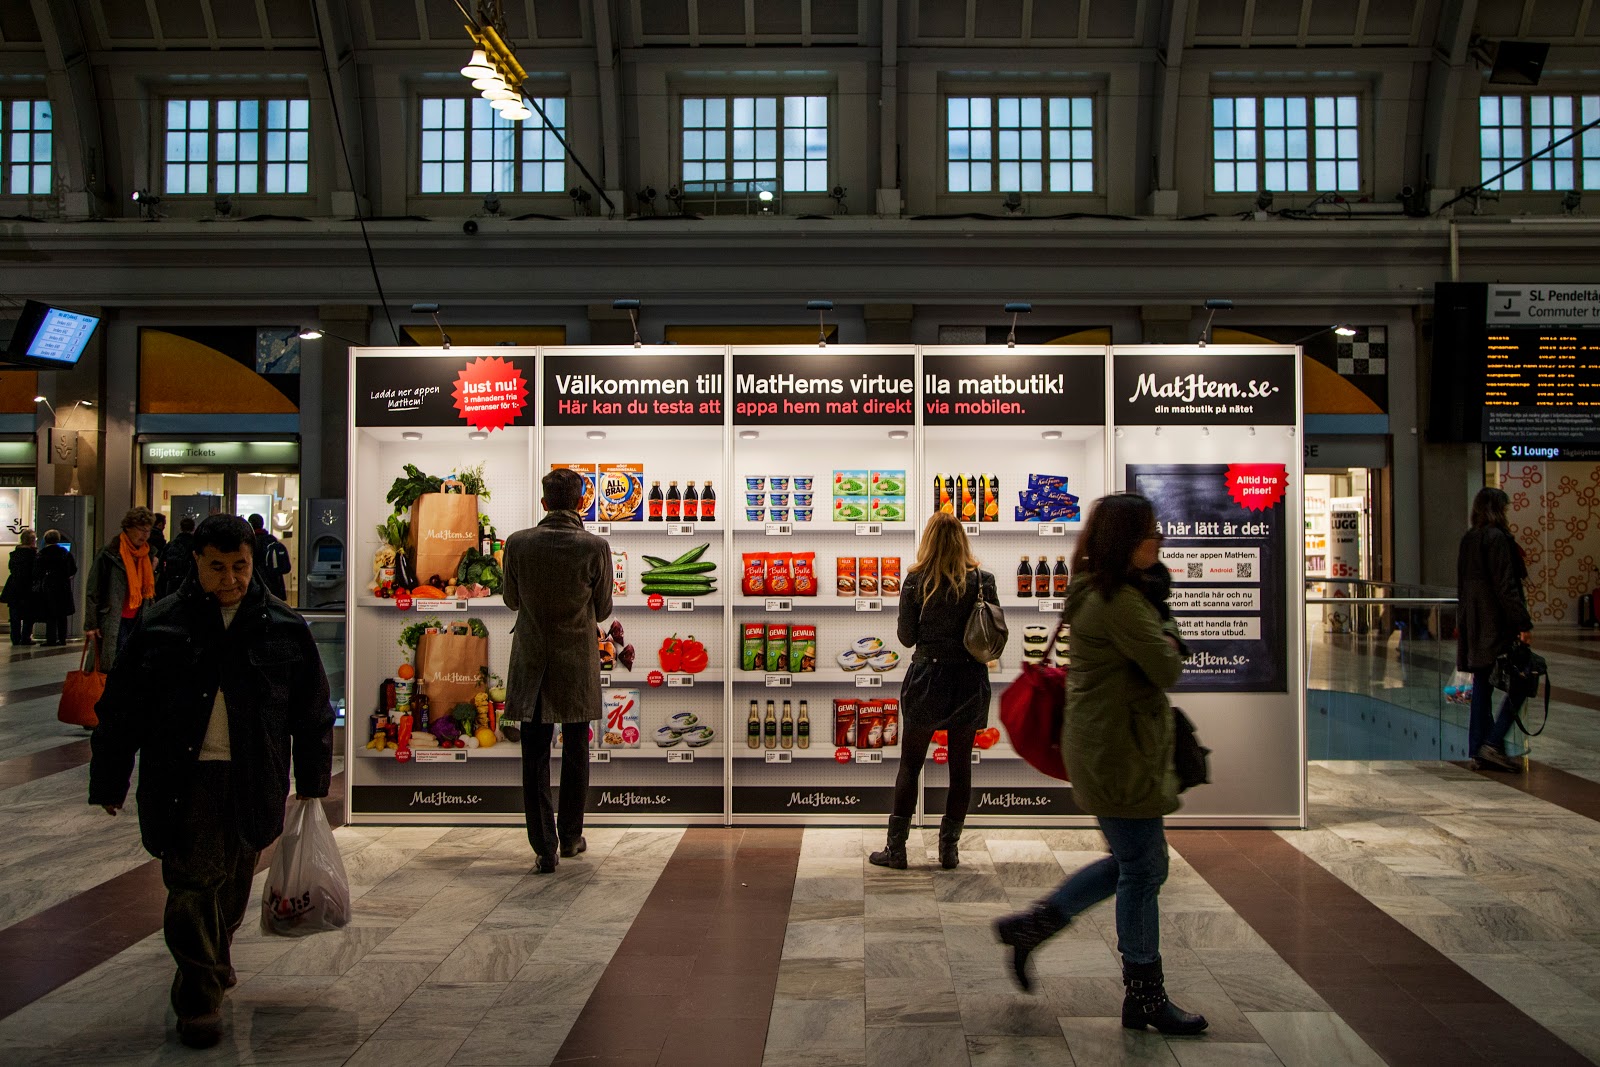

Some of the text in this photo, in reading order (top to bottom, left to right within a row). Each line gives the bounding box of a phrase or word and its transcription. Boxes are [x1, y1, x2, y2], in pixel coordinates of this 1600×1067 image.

[1530, 290, 1545, 301] SL
[1504, 298, 1511, 309] J
[1528, 306, 1588, 317] Commuter
[463, 378, 517, 394] Just nu!
[555, 374, 689, 394] Välkommen
[696, 374, 722, 393] till
[736, 374, 844, 394] MatHems
[850, 374, 913, 394] virtue
[959, 374, 1064, 394] matbutik!
[371, 386, 440, 399] Ladda ner appen
[470, 394, 504, 403] månaders
[465, 404, 499, 412] leveranser
[558, 399, 1025, 416] Här kan du testa att appa hem mat direkt via mobilen.
[1155, 405, 1253, 414] din matbutik på nätet
[150, 448, 184, 458] Biljetter
[1305, 445, 1318, 457] SE
[1512, 446, 1559, 458] SJ Lounge
[0, 476, 22, 487] TIK
[607, 480, 624, 488] ALL-
[1237, 476, 1277, 484] Alltid bra
[605, 487, 626, 497] BRAN
[1243, 486, 1271, 496] priser!
[1167, 522, 1191, 535] här
[1195, 522, 1219, 535] lätt
[1223, 522, 1238, 535] är
[1241, 522, 1269, 535] det:
[1332, 563, 1358, 577] 65:-
[1169, 592, 1182, 600] örja
